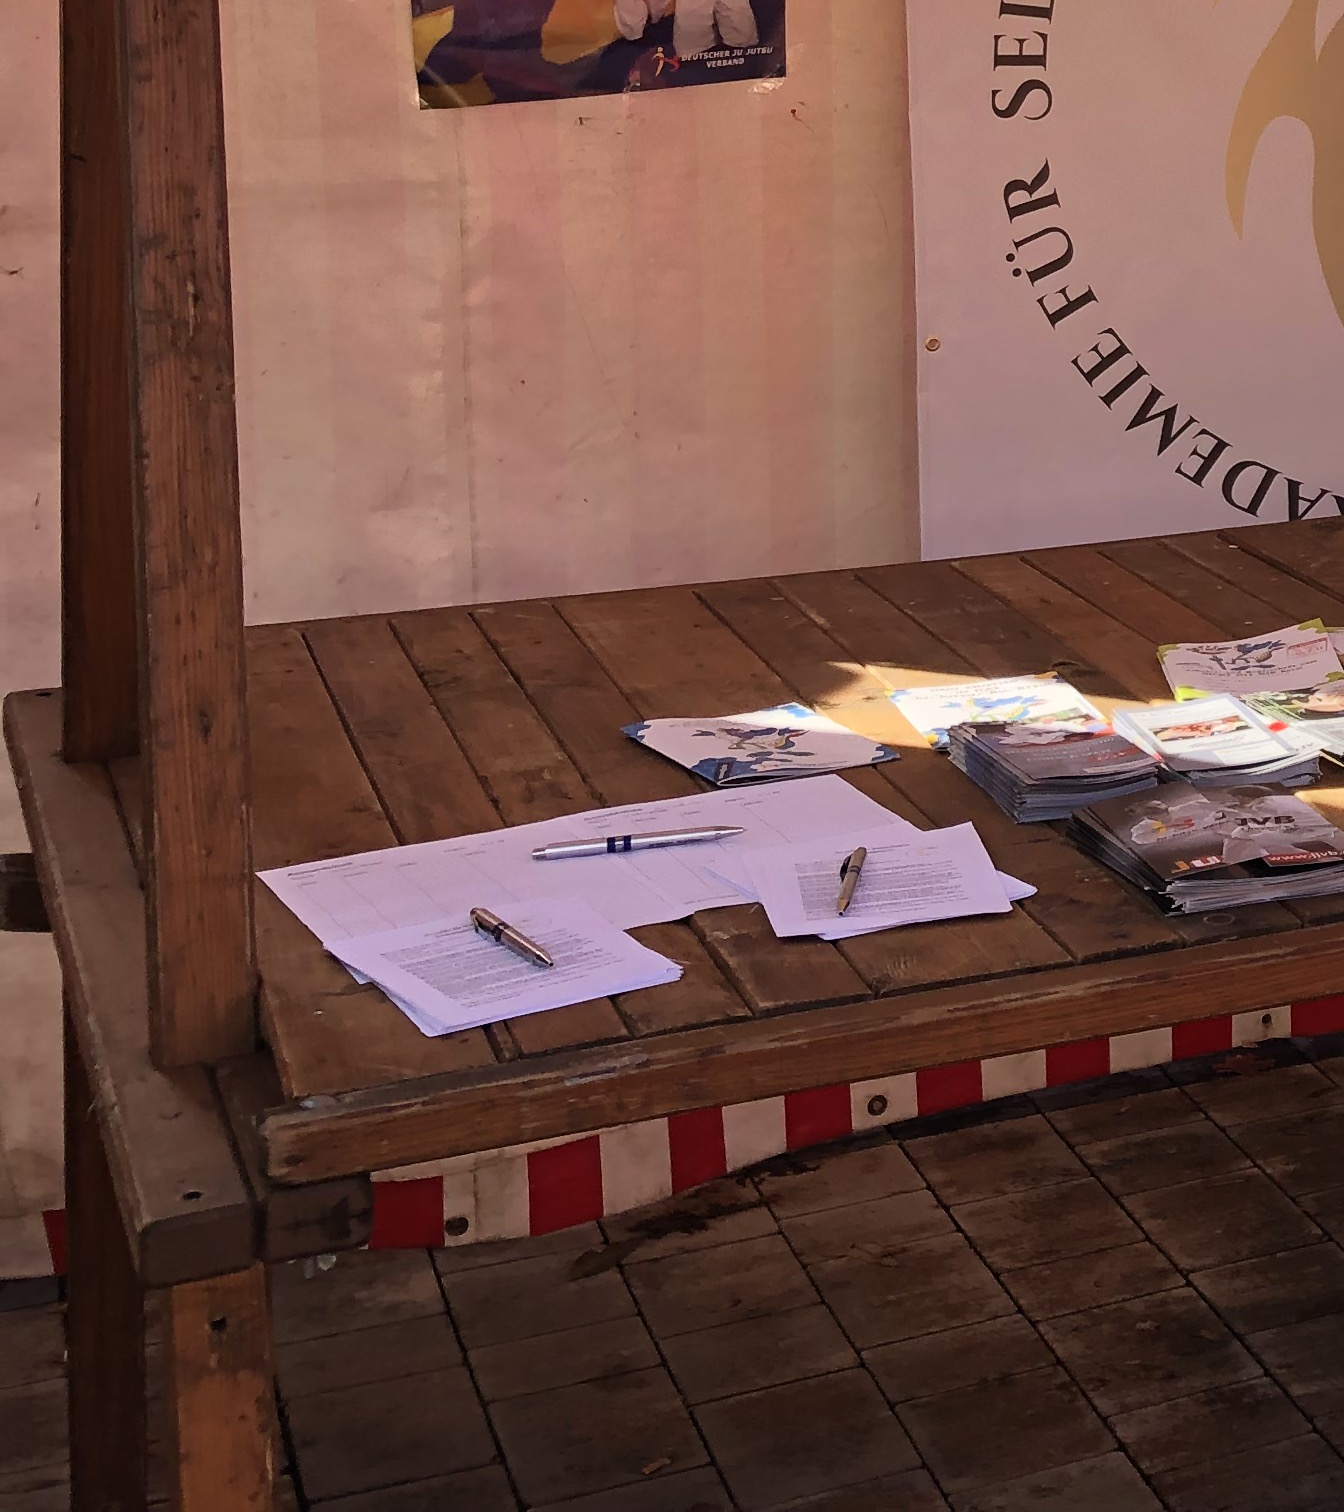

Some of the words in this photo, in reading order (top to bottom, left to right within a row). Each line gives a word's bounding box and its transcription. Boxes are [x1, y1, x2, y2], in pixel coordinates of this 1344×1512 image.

[732, 49, 743, 57] JU
[745, 47, 774, 55] JUTSU
[1003, 158, 1099, 331] FÜR
